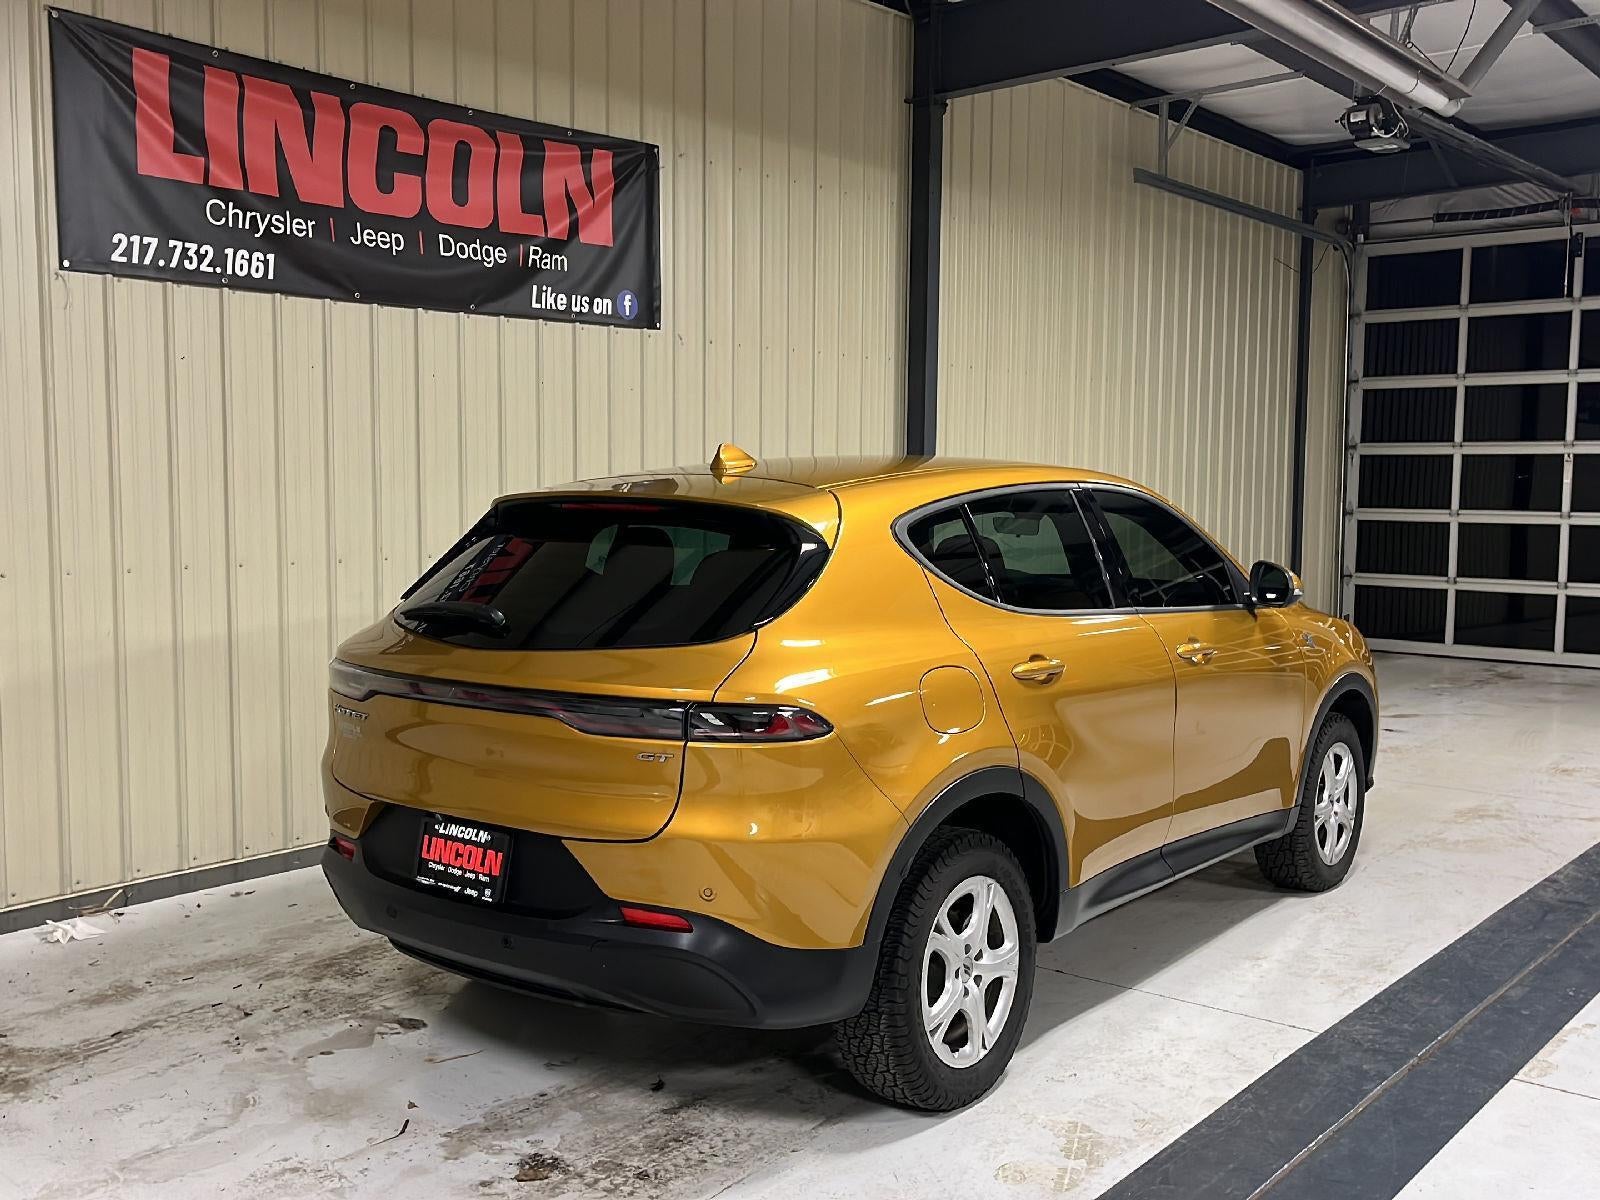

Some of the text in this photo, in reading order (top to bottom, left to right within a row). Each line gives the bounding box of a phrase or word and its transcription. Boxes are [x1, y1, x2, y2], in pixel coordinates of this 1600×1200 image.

[132, 47, 614, 248] LINCOLN
[205, 198, 568, 272] Chrysler Jeep Dodge Ram
[110, 232, 275, 280] 217.732.1661
[531, 284, 568, 311] Like
[571, 294, 590, 313] us
[592, 297, 612, 315] on
[635, 751, 675, 763] GT
[438, 822, 489, 844] LINCOLN
[421, 834, 504, 877] LINCOLN
[447, 866, 463, 877] Dodge
[464, 871, 476, 880] Jeep
[478, 873, 490, 883] Ram
